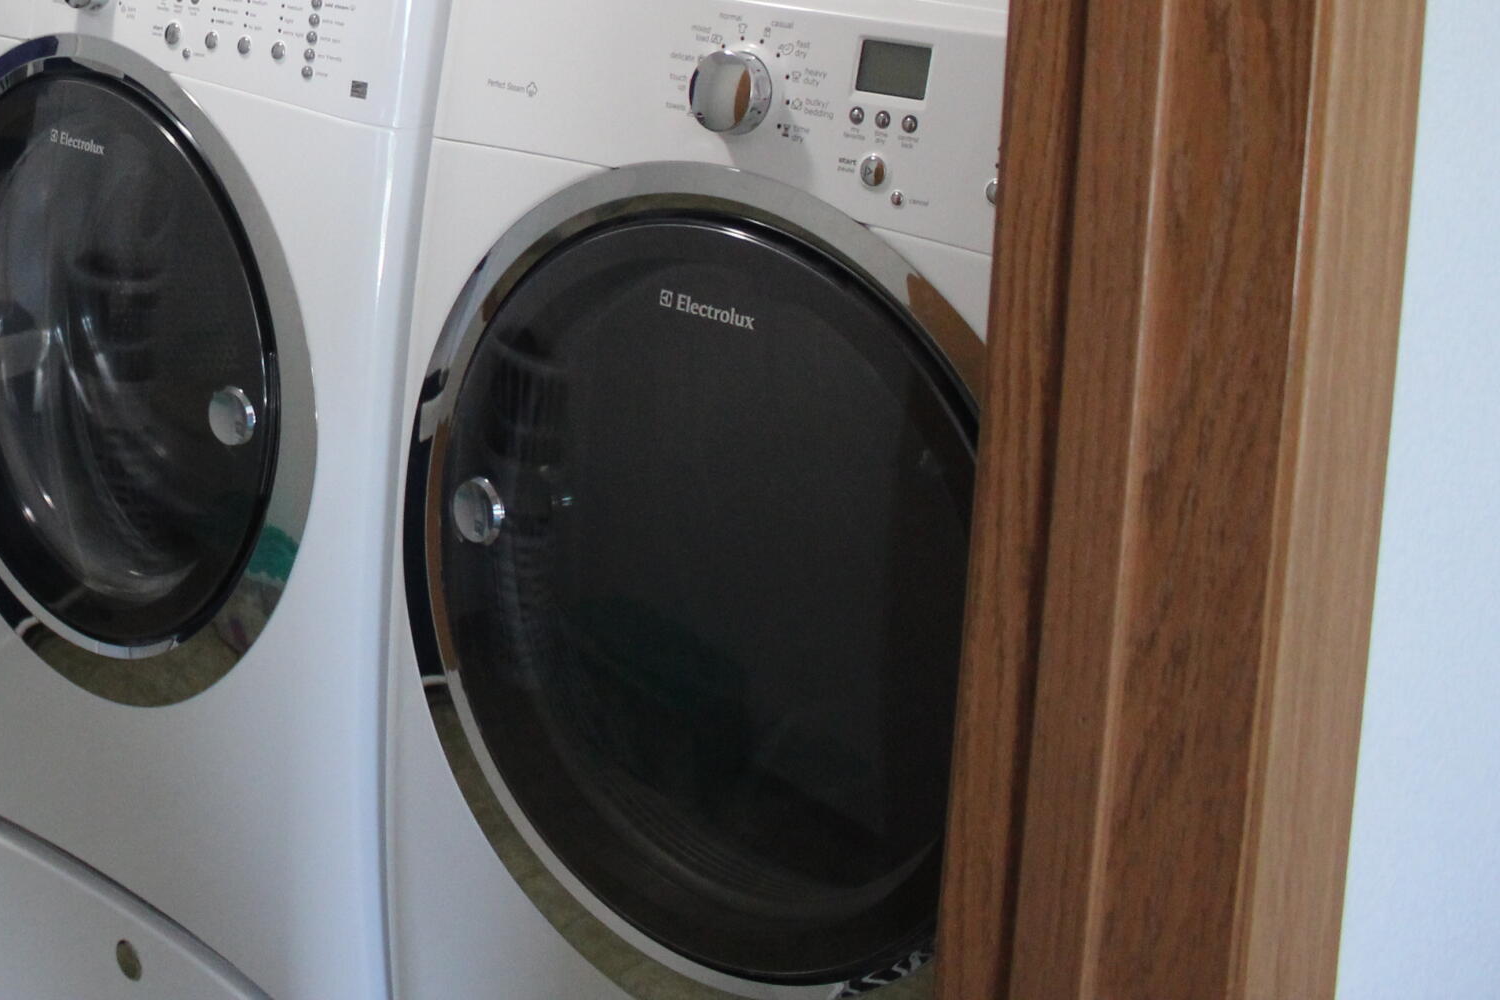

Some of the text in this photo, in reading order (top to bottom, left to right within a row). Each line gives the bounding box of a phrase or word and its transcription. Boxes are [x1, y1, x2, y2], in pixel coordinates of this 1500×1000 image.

[804, 67, 828, 80] heavy
[803, 107, 836, 121] bedding
[60, 131, 105, 156] Electrolux
[676, 293, 756, 331] Electrolux
